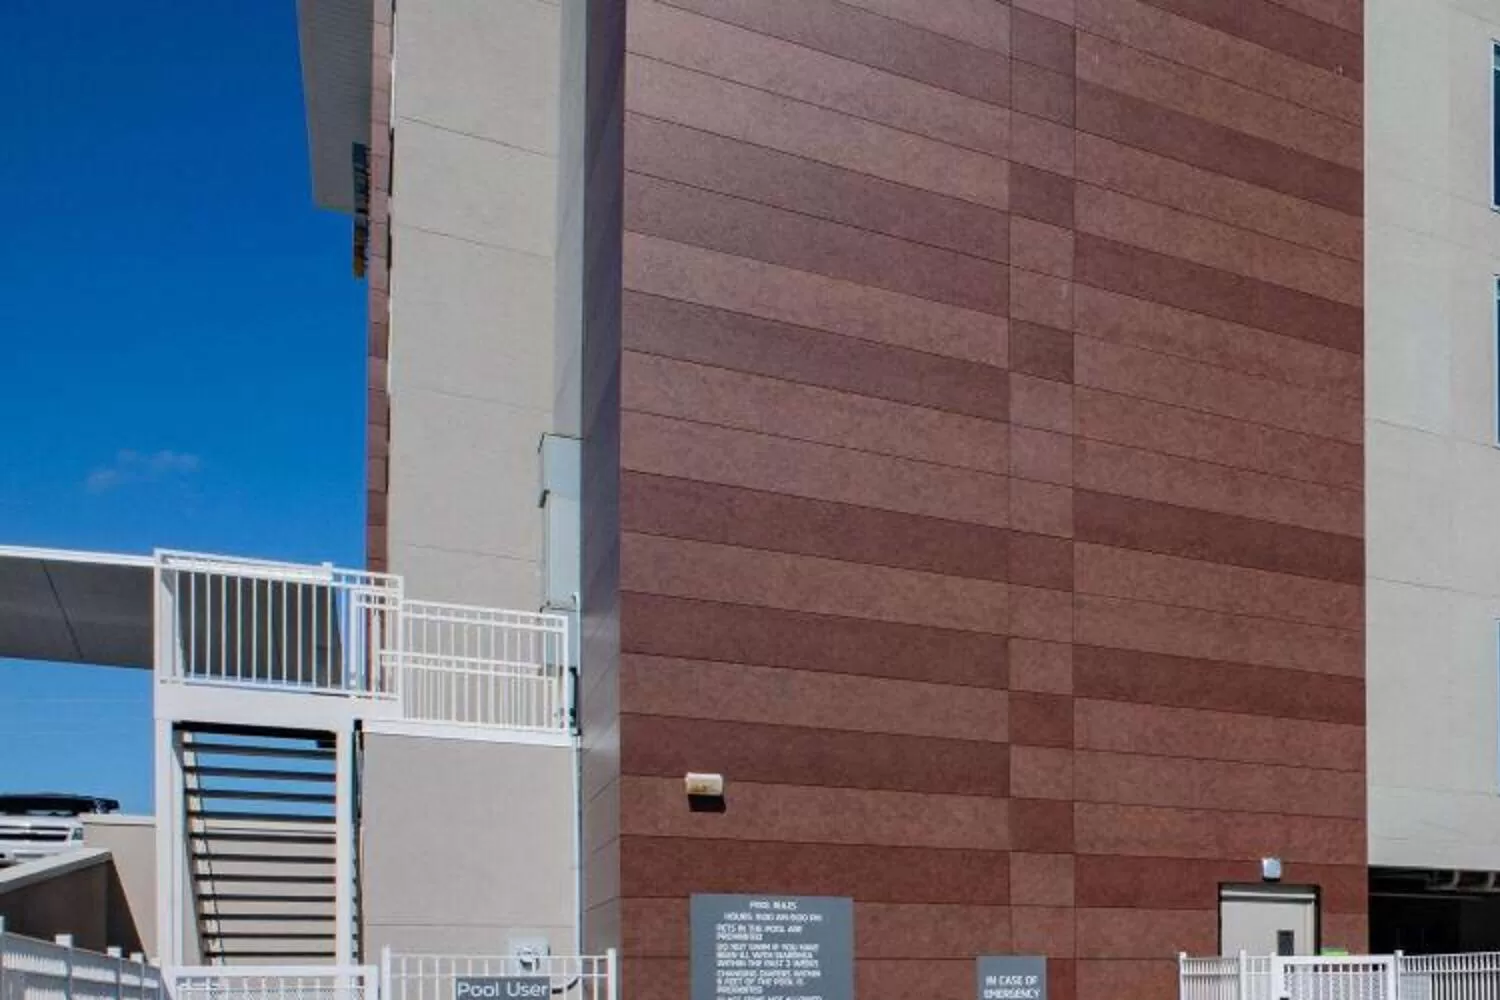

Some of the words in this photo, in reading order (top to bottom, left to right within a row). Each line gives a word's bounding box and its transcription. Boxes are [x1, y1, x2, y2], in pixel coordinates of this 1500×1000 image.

[985, 975, 997, 986] IN
[998, 975, 1023, 986] CASE
[1025, 975, 1039, 986] OF
[457, 981, 499, 998] Pool
[507, 981, 548, 998] User
[983, 988, 1041, 999] EMERGENCY
